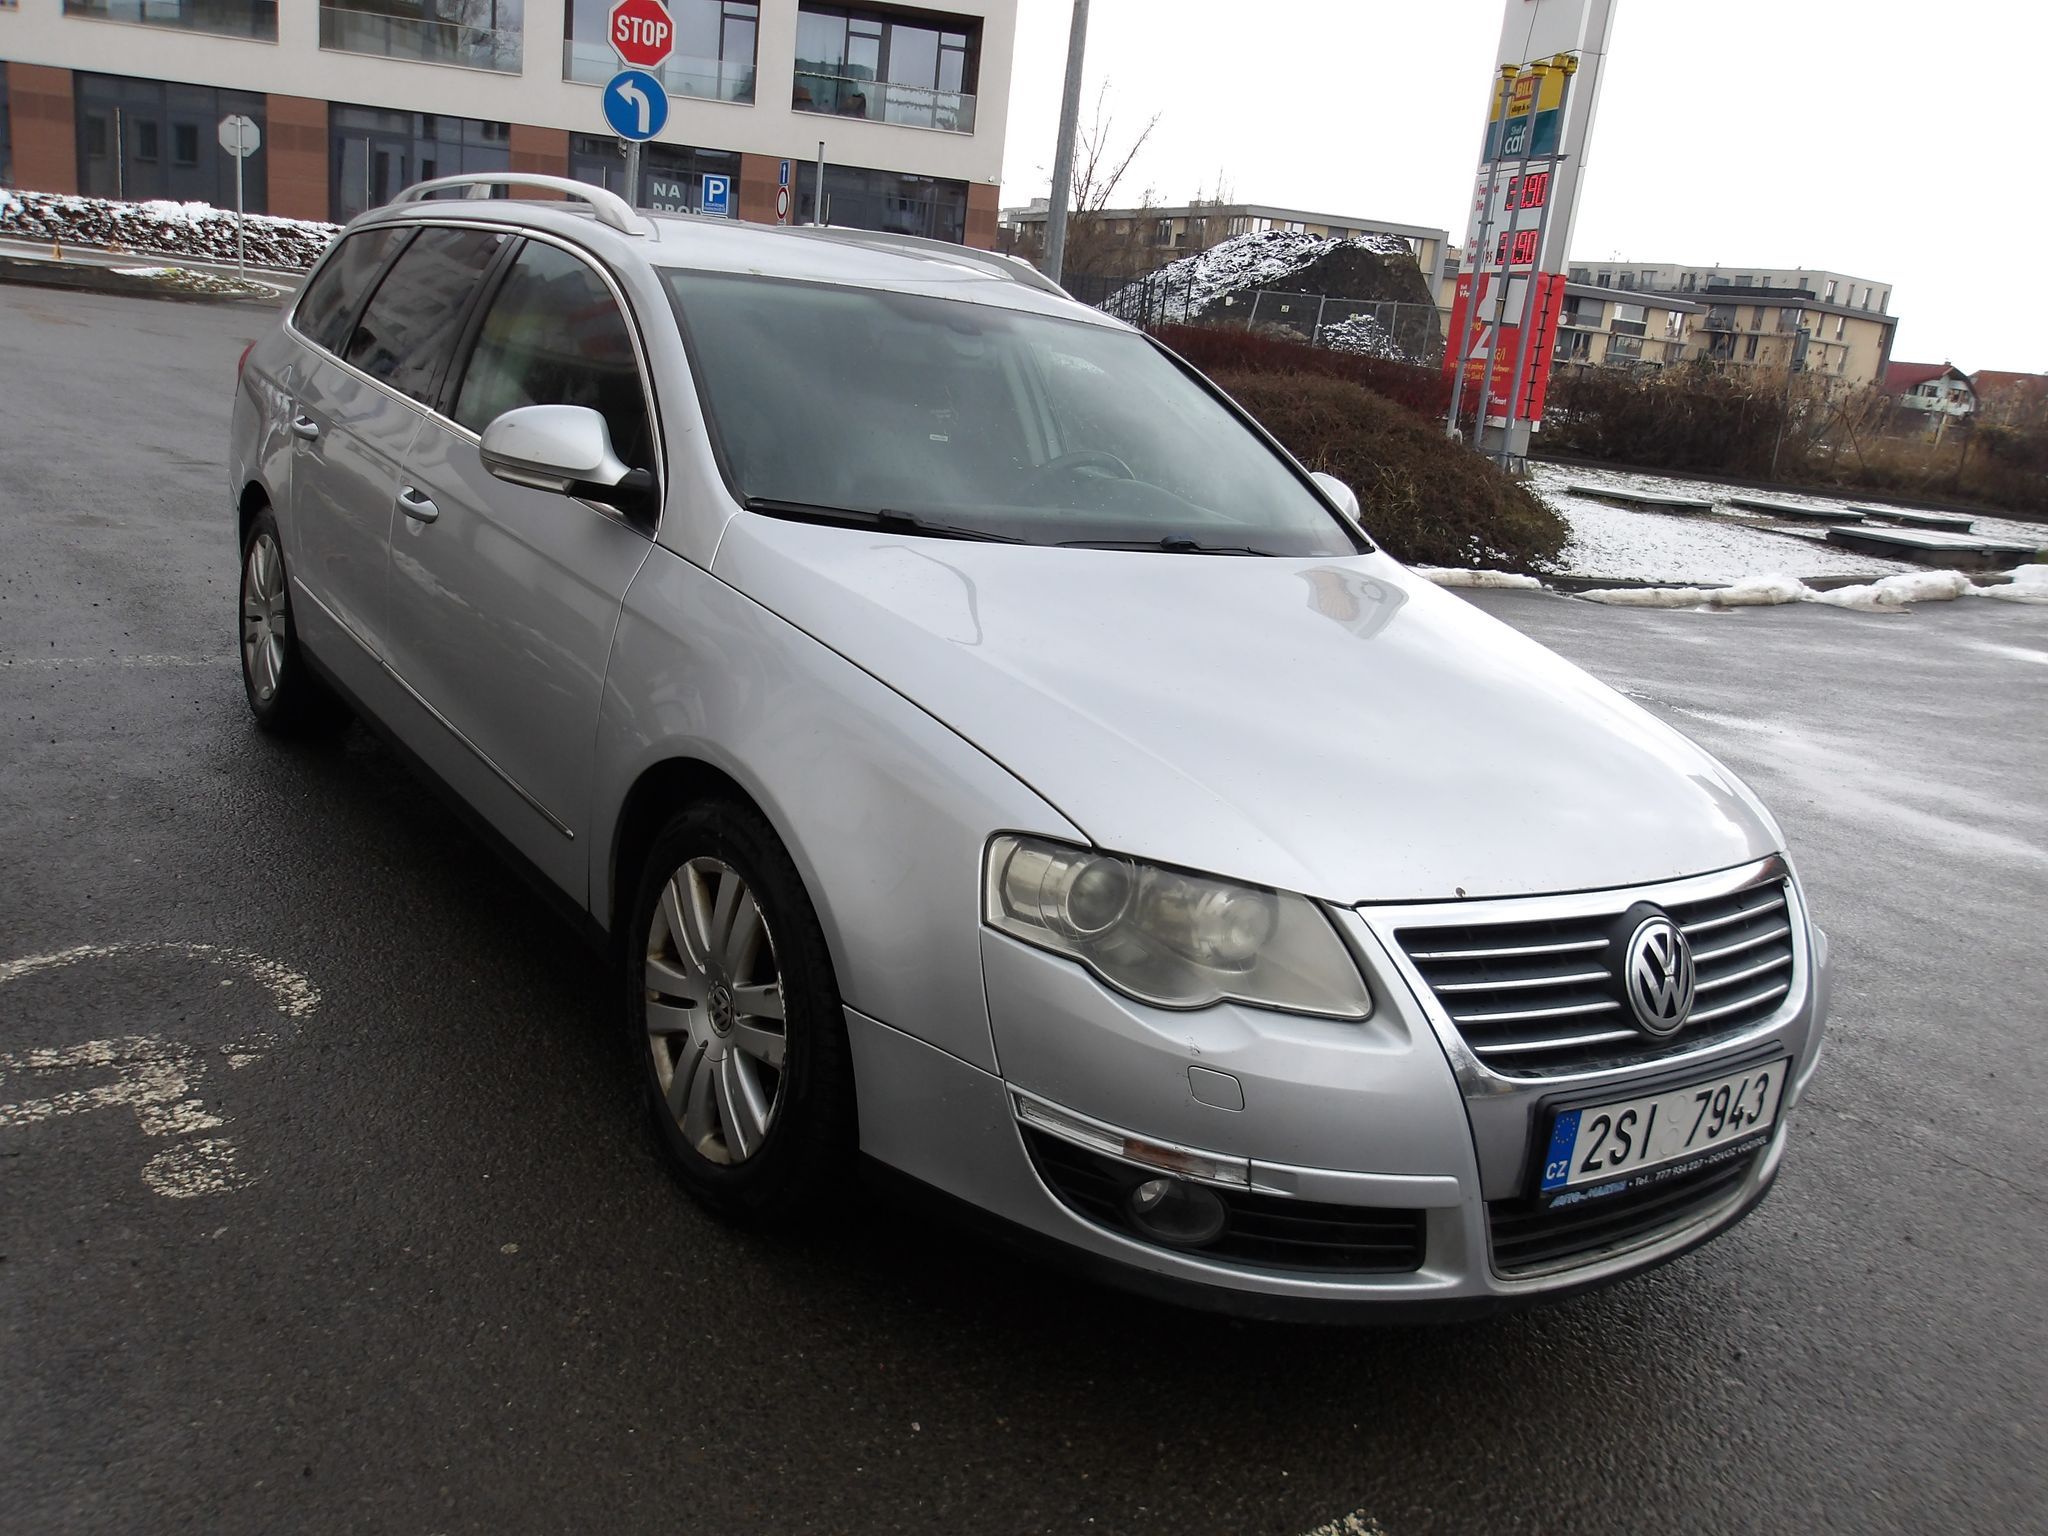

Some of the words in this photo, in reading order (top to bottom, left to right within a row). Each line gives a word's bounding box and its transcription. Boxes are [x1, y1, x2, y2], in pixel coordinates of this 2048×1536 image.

[616, 15, 668, 48] STOP
[1516, 79, 1534, 96] BILL
[1504, 126, 1527, 154] caf
[653, 182, 681, 198] NA
[708, 179, 725, 202] P
[1579, 1103, 1658, 1173] 2SI
[1684, 1072, 1770, 1147] 7943
[1545, 1160, 1568, 1180] CZ
